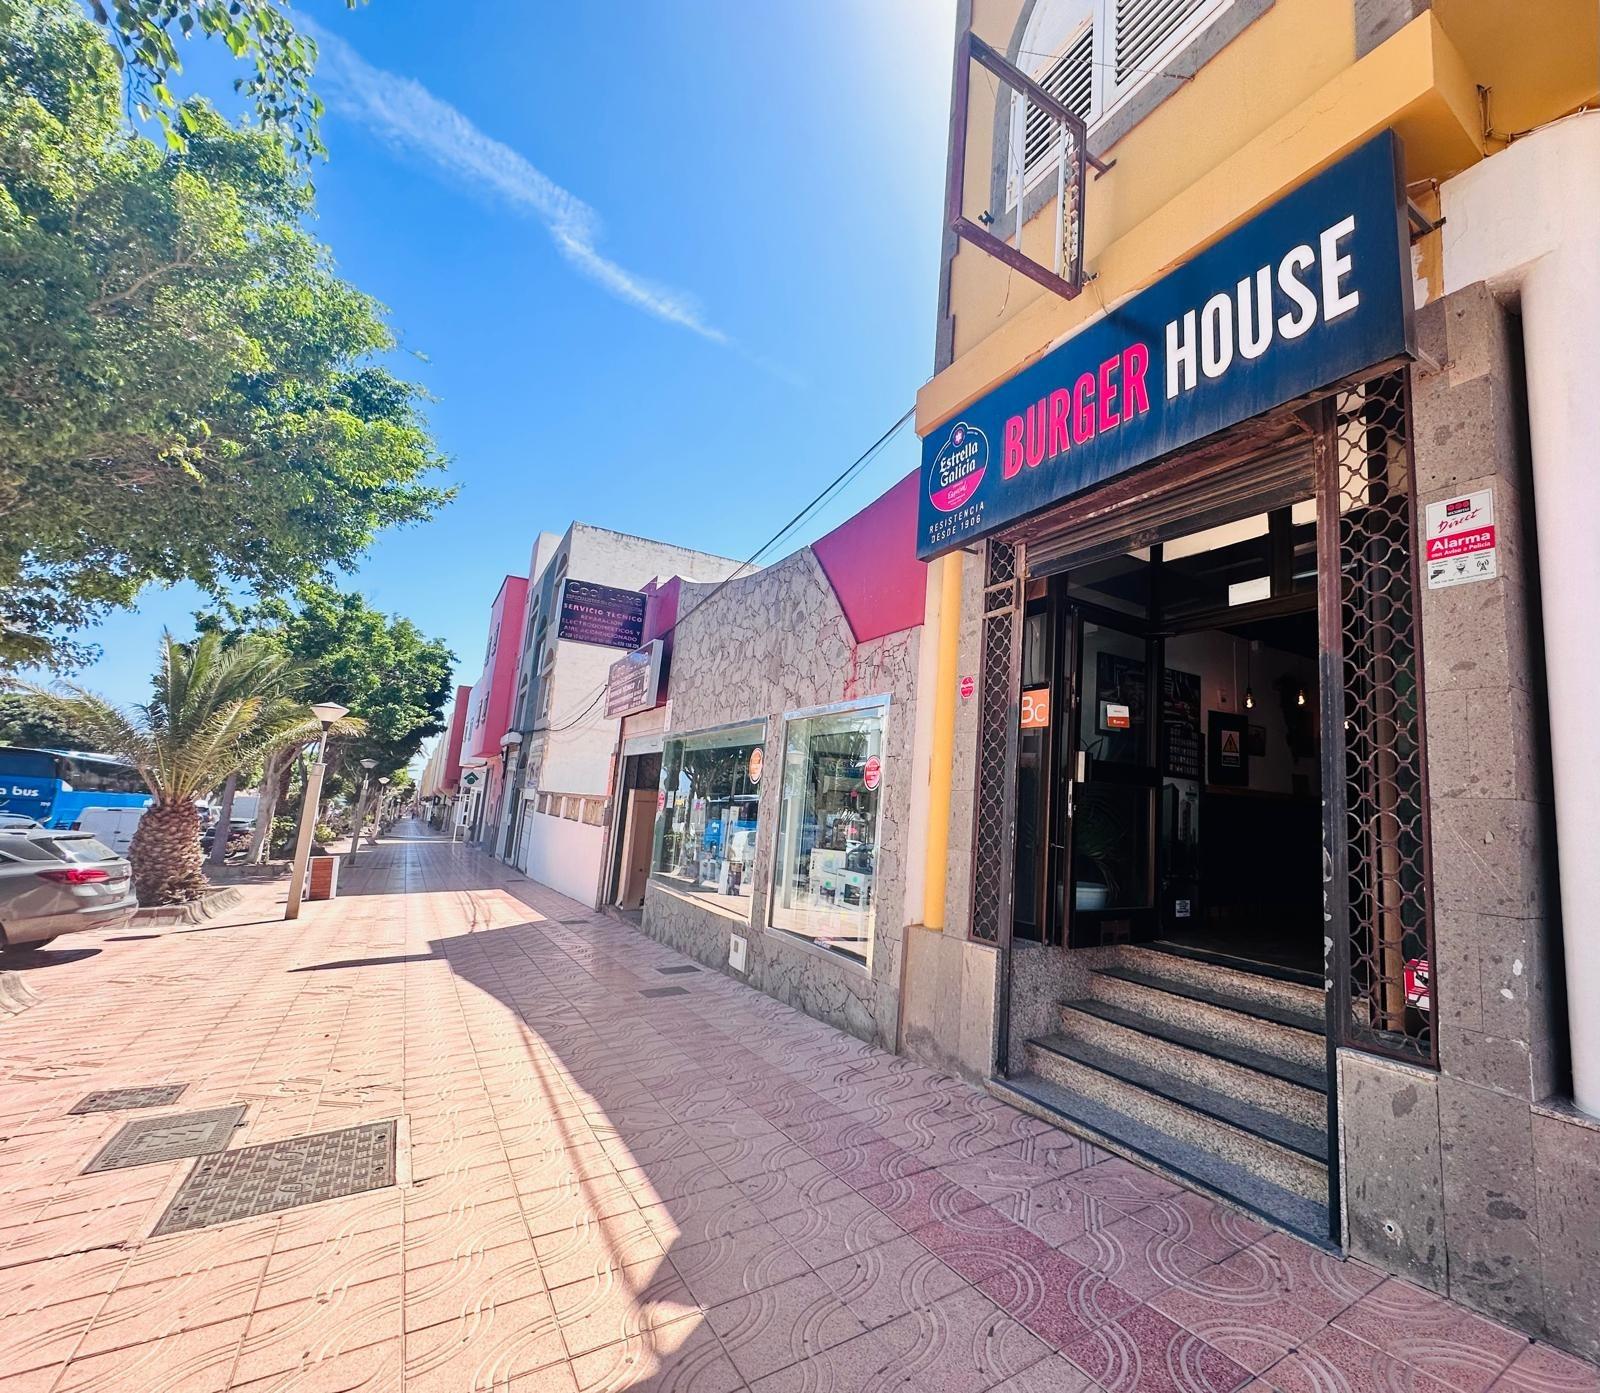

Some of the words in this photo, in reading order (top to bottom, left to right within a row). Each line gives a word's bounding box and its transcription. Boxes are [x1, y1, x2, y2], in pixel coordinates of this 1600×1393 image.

[1004, 343, 1150, 480] BURGER
[1166, 214, 1360, 400] HOUSE
[940, 441, 978, 473] Estrella
[940, 459, 976, 487] Galicia
[929, 501, 984, 534] RESISTENCIA
[931, 525, 957, 544] DESDE
[960, 514, 981, 530] 1906
[1438, 508, 1482, 533] Direct
[1431, 532, 1491, 552] Alarma
[563, 603, 604, 615] SERVICIO
[12, 785, 40, 797] bus
